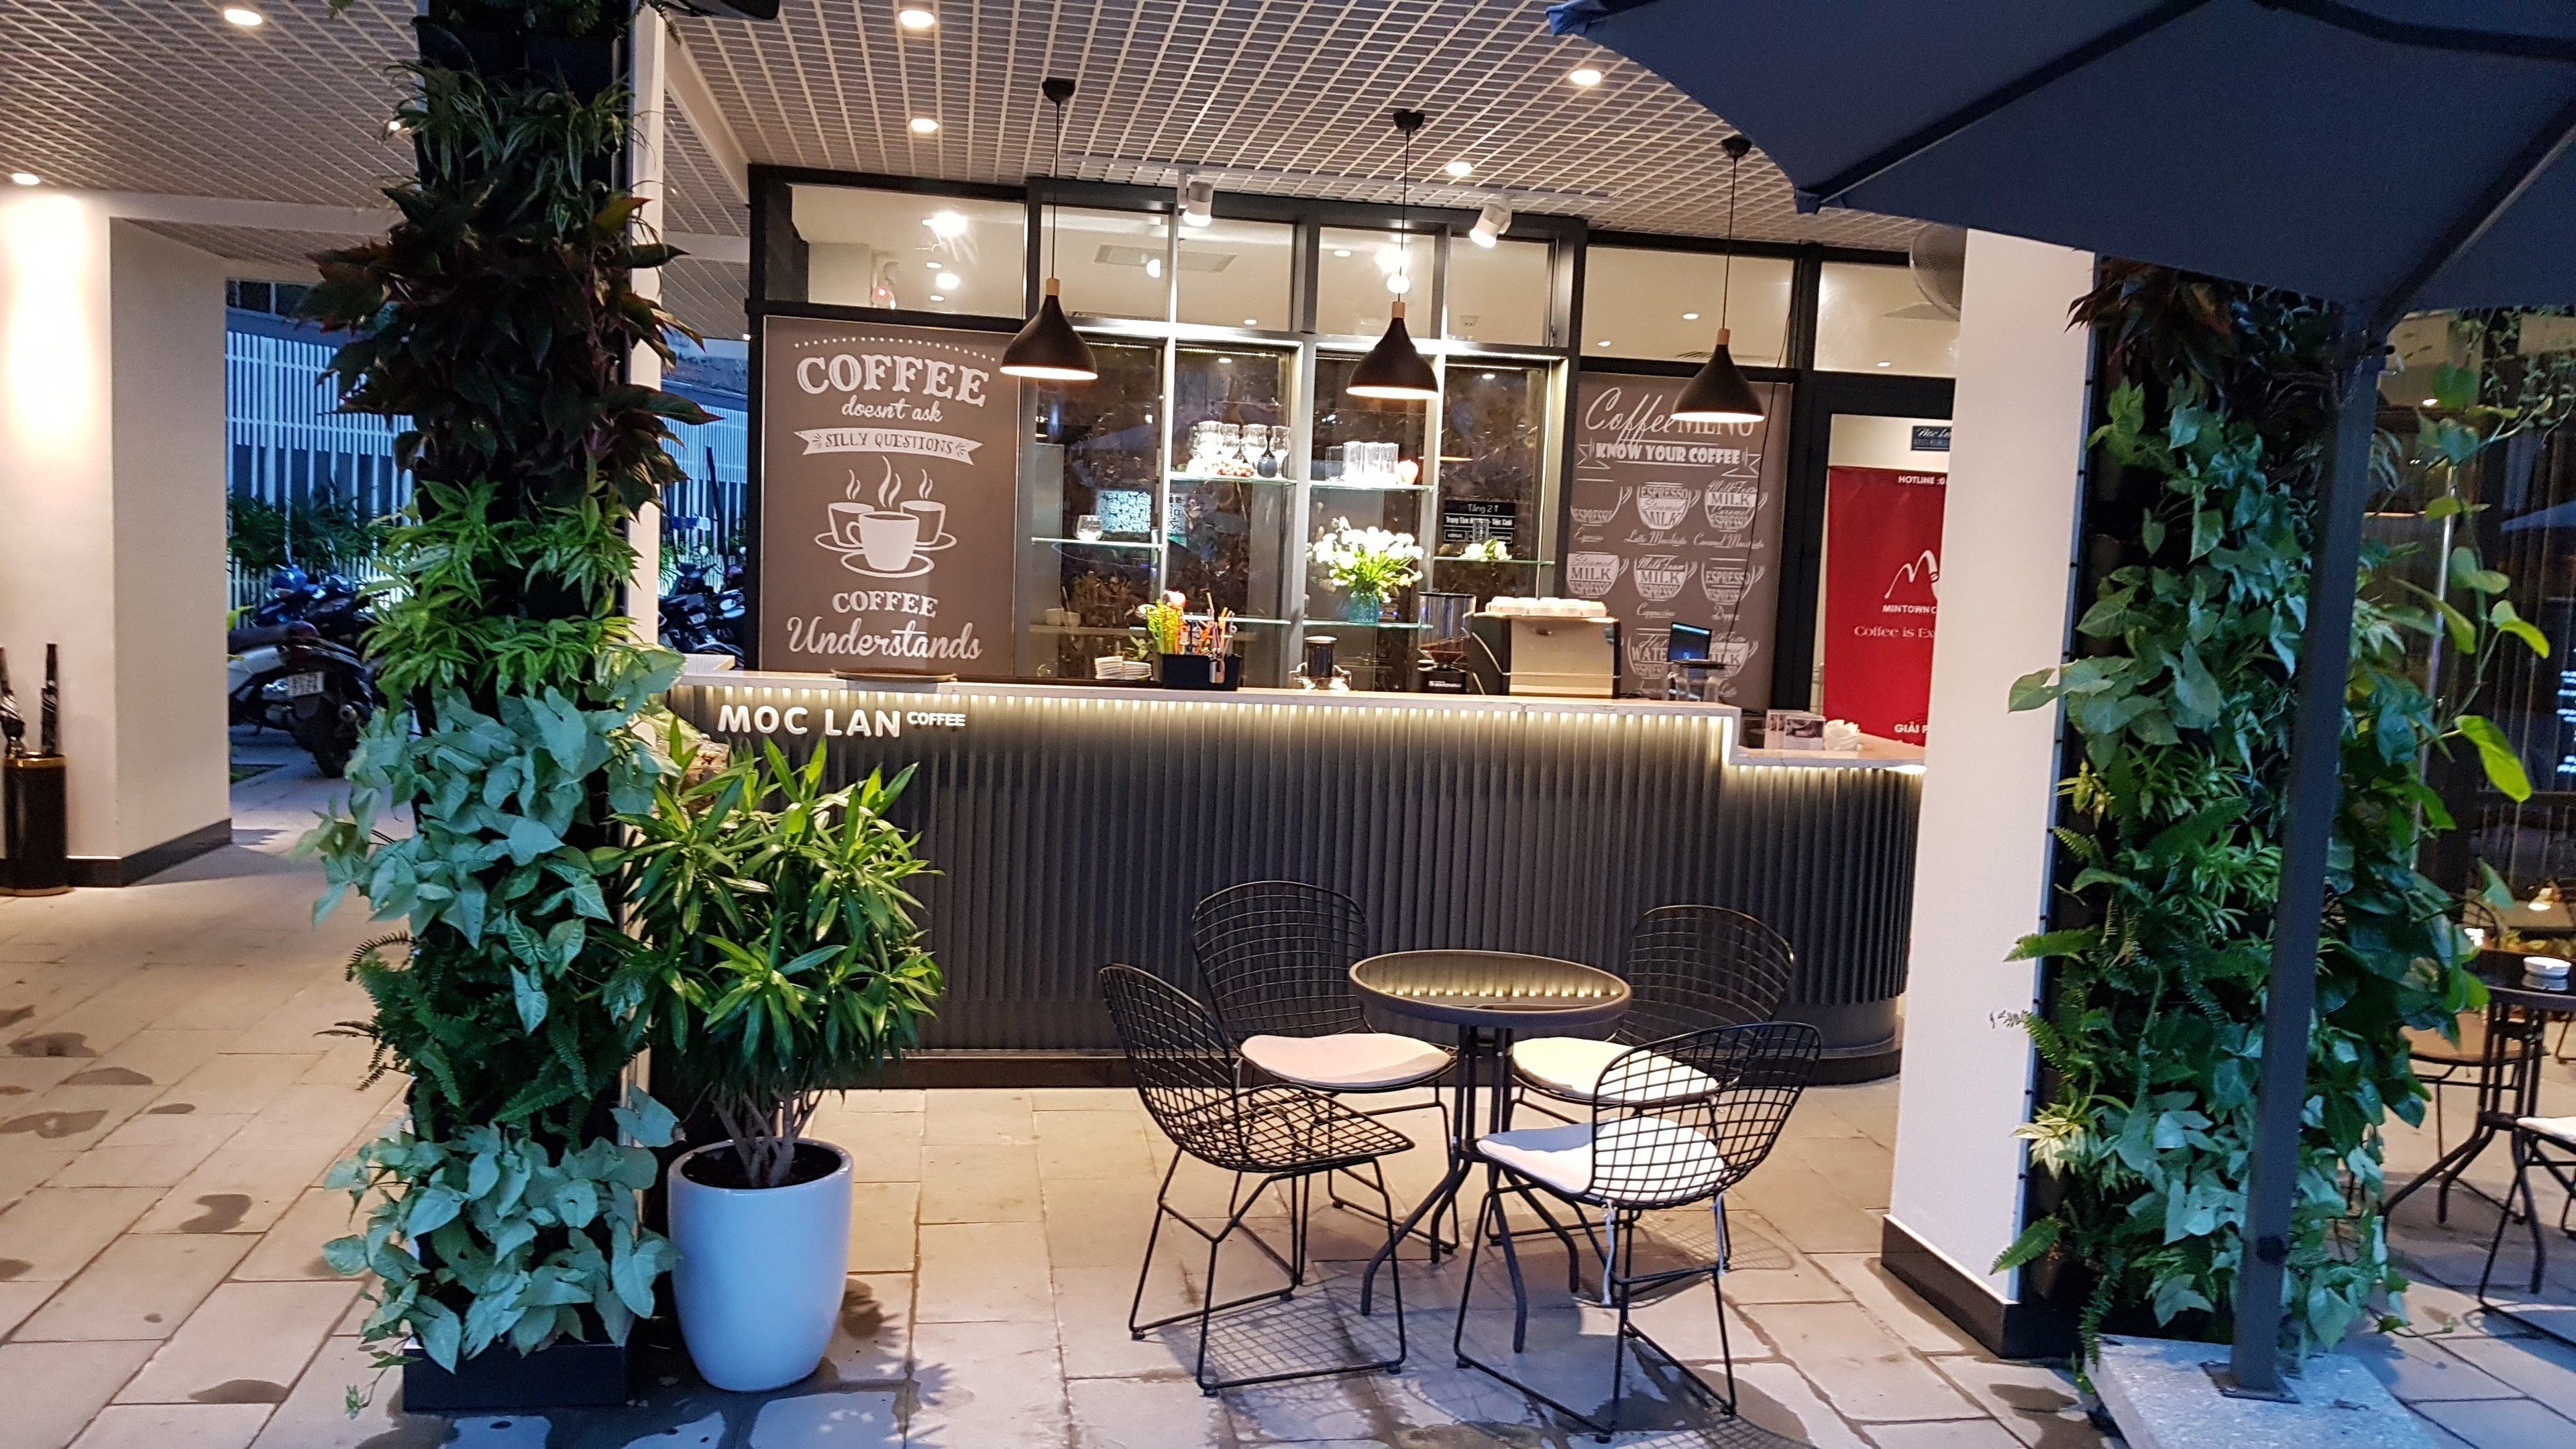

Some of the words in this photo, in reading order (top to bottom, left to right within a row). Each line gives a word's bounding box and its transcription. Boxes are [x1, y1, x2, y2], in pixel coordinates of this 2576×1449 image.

[796, 354, 990, 407] COFFEE
[911, 400, 943, 423] ask
[1585, 386, 1675, 447] Coffee
[825, 433, 868, 447] SILLY
[875, 433, 953, 454] QUESTIONS
[1594, 442, 1643, 460] KNOW
[1646, 444, 1687, 462] YOUR
[1688, 446, 1741, 464] COFFEE
[1898, 475, 1935, 484] HOTLINE
[1641, 486, 1688, 498] ESPRESSO
[1711, 493, 1749, 506] MILK
[1571, 567, 1611, 580] MILK
[1640, 571, 1678, 584] MILK
[832, 590, 938, 618] COFFEE
[1882, 604, 1930, 613] MINTOWN
[786, 616, 983, 659] Understands
[1854, 626, 1899, 637] Coffee
[1902, 627, 1915, 637] is
[717, 704, 808, 735] MOC
[824, 708, 901, 737] LAN
[906, 711, 966, 727] COFFEE
